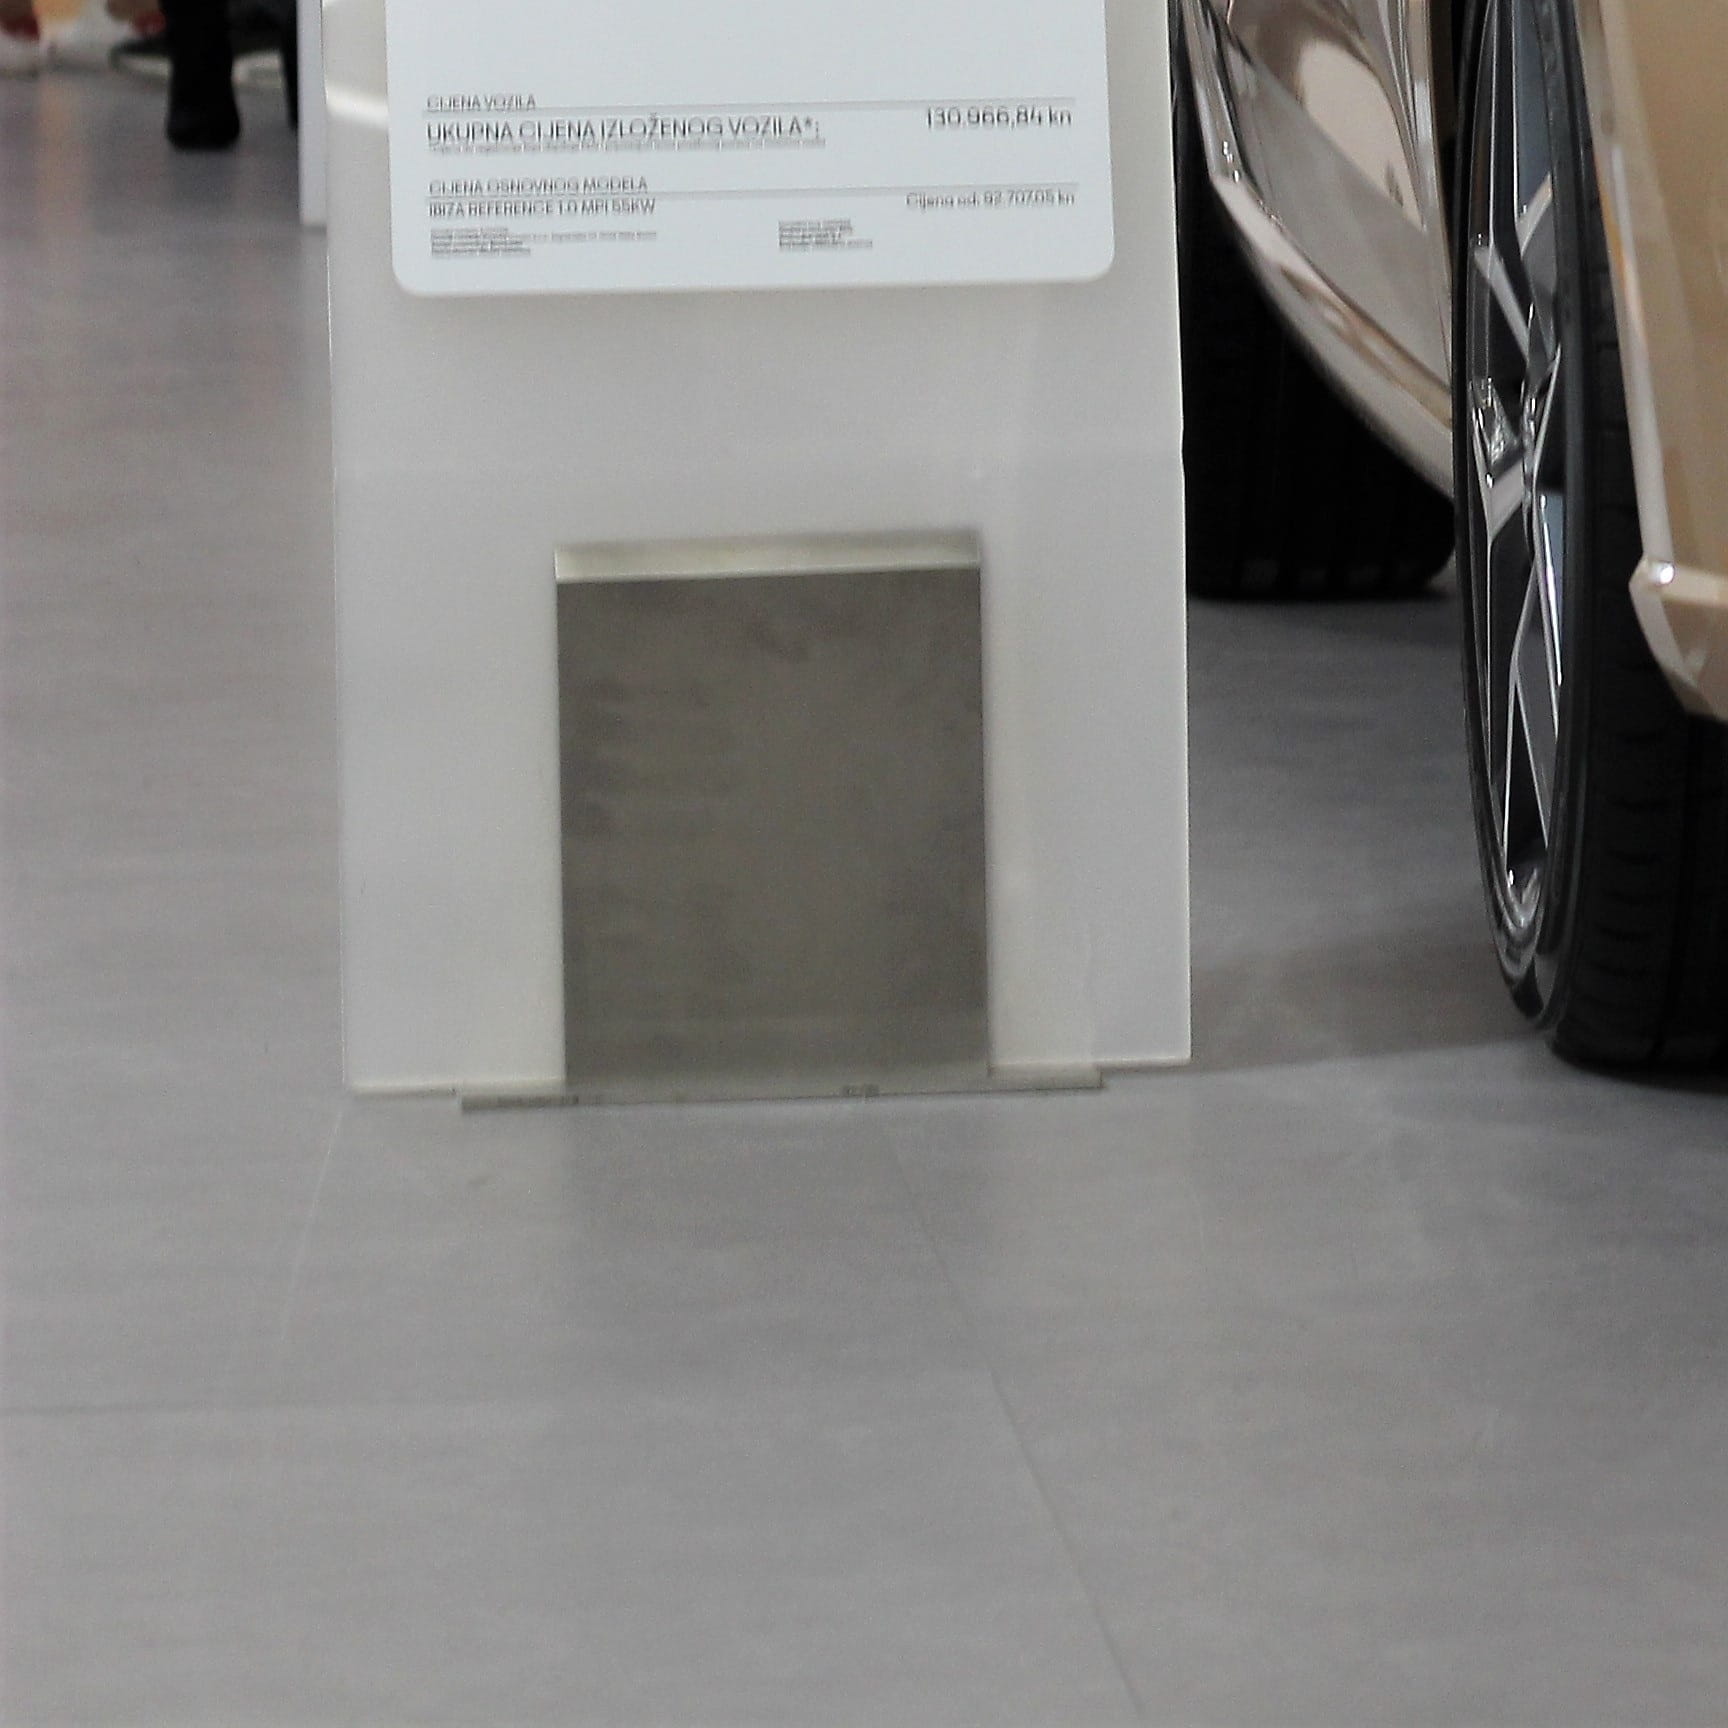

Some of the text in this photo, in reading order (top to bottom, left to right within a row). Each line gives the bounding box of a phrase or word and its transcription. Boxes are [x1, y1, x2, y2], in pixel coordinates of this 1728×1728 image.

[426, 119, 514, 144] UKUPNA
[518, 118, 595, 143] CIJENA
[599, 112, 724, 140] IZLOŽENOG
